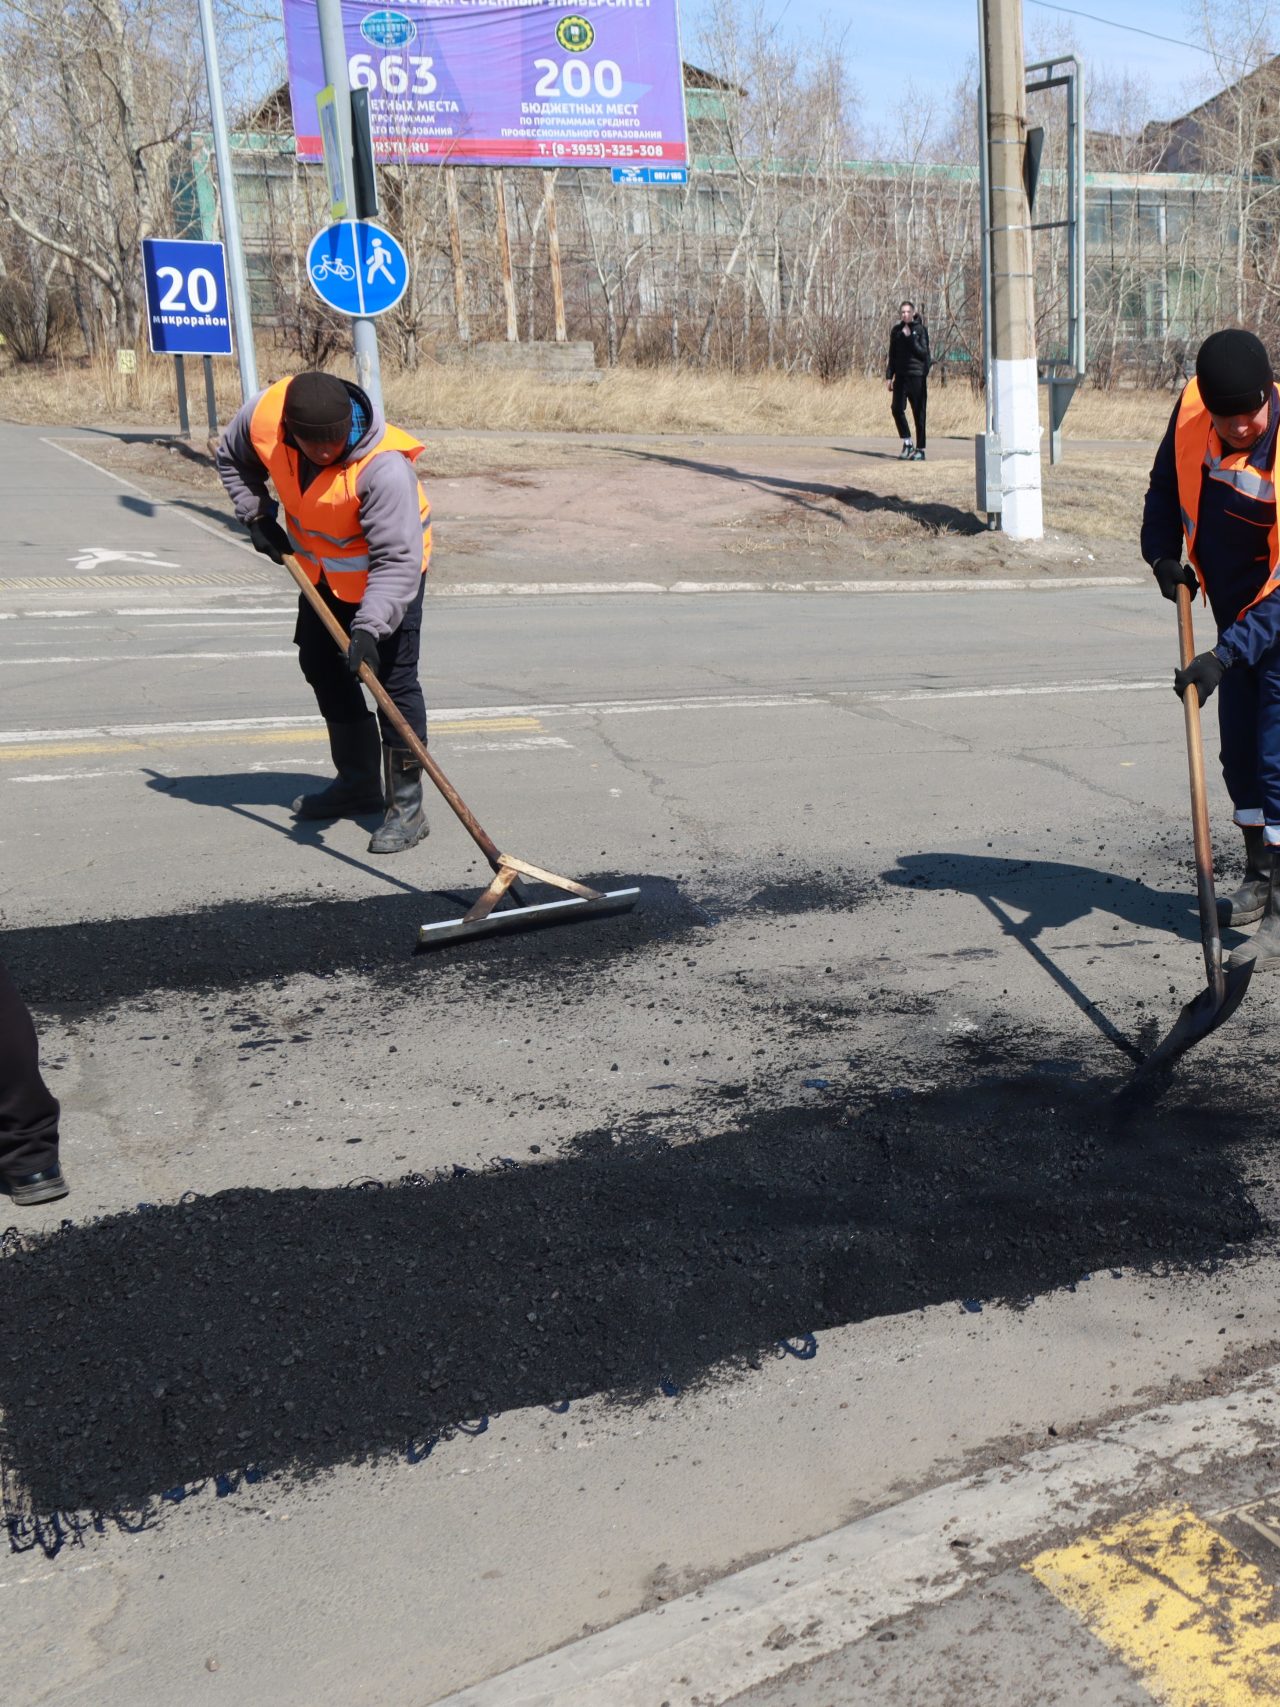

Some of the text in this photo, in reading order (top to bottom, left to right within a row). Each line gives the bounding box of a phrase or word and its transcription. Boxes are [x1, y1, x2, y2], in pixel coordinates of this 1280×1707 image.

[348, 54, 437, 95] 663
[534, 59, 622, 98] 200
[371, 99, 459, 113] ЕТНЫХ МЕСТА
[521, 102, 639, 115] БЮДЖЕТНЫХ МЕСТ
[519, 117, 640, 127] ПО ПРОГРАММАМ СРЕДНЕГО
[501, 128, 662, 139] ПРОФЕССИОНАЛЬНОГО ОБРАЗОВАНИЯ
[552, 142, 663, 158] (8-3953)-325-308
[156, 266, 217, 313] 20
[152, 314, 227, 327] микрорайон
